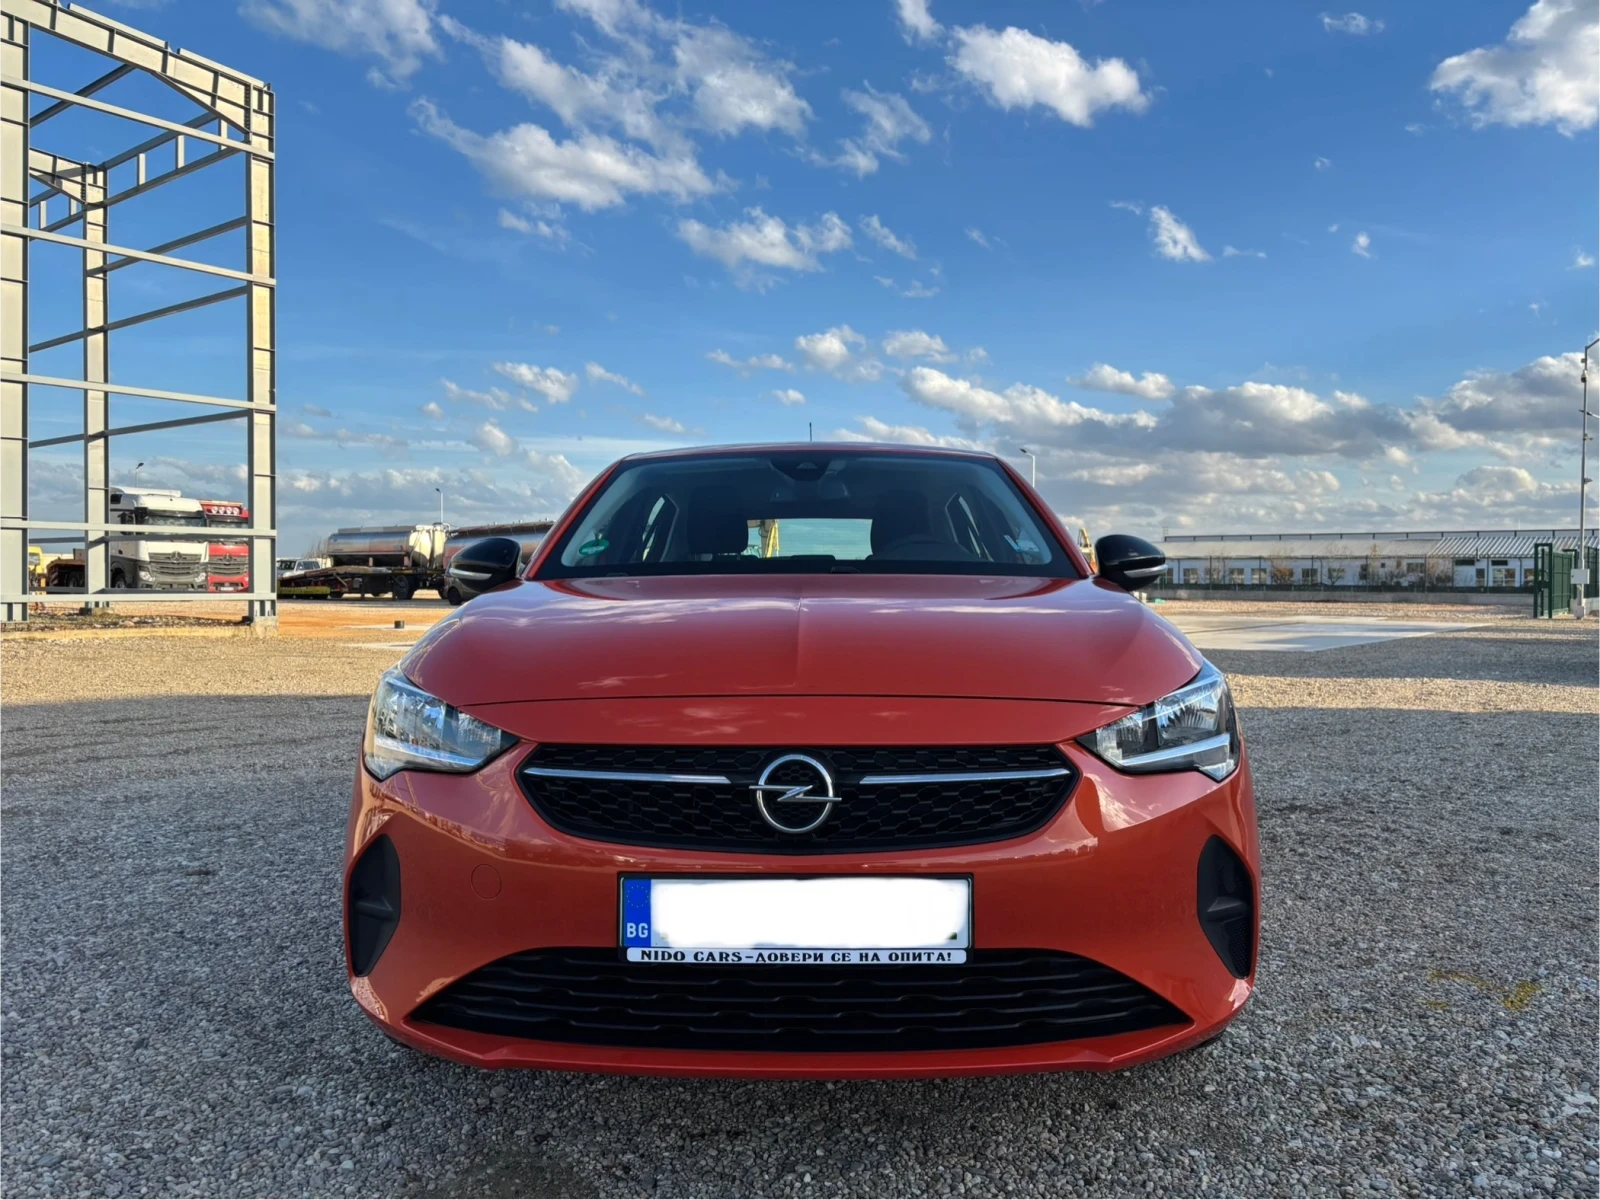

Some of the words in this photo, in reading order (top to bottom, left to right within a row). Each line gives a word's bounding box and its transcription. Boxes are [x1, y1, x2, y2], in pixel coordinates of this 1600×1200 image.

[626, 922, 649, 938] BG
[640, 949, 686, 962] NIDO
[830, 951, 852, 963] СЕ
[859, 951, 881, 963] НА
[888, 951, 952, 963] ОПИТА!
